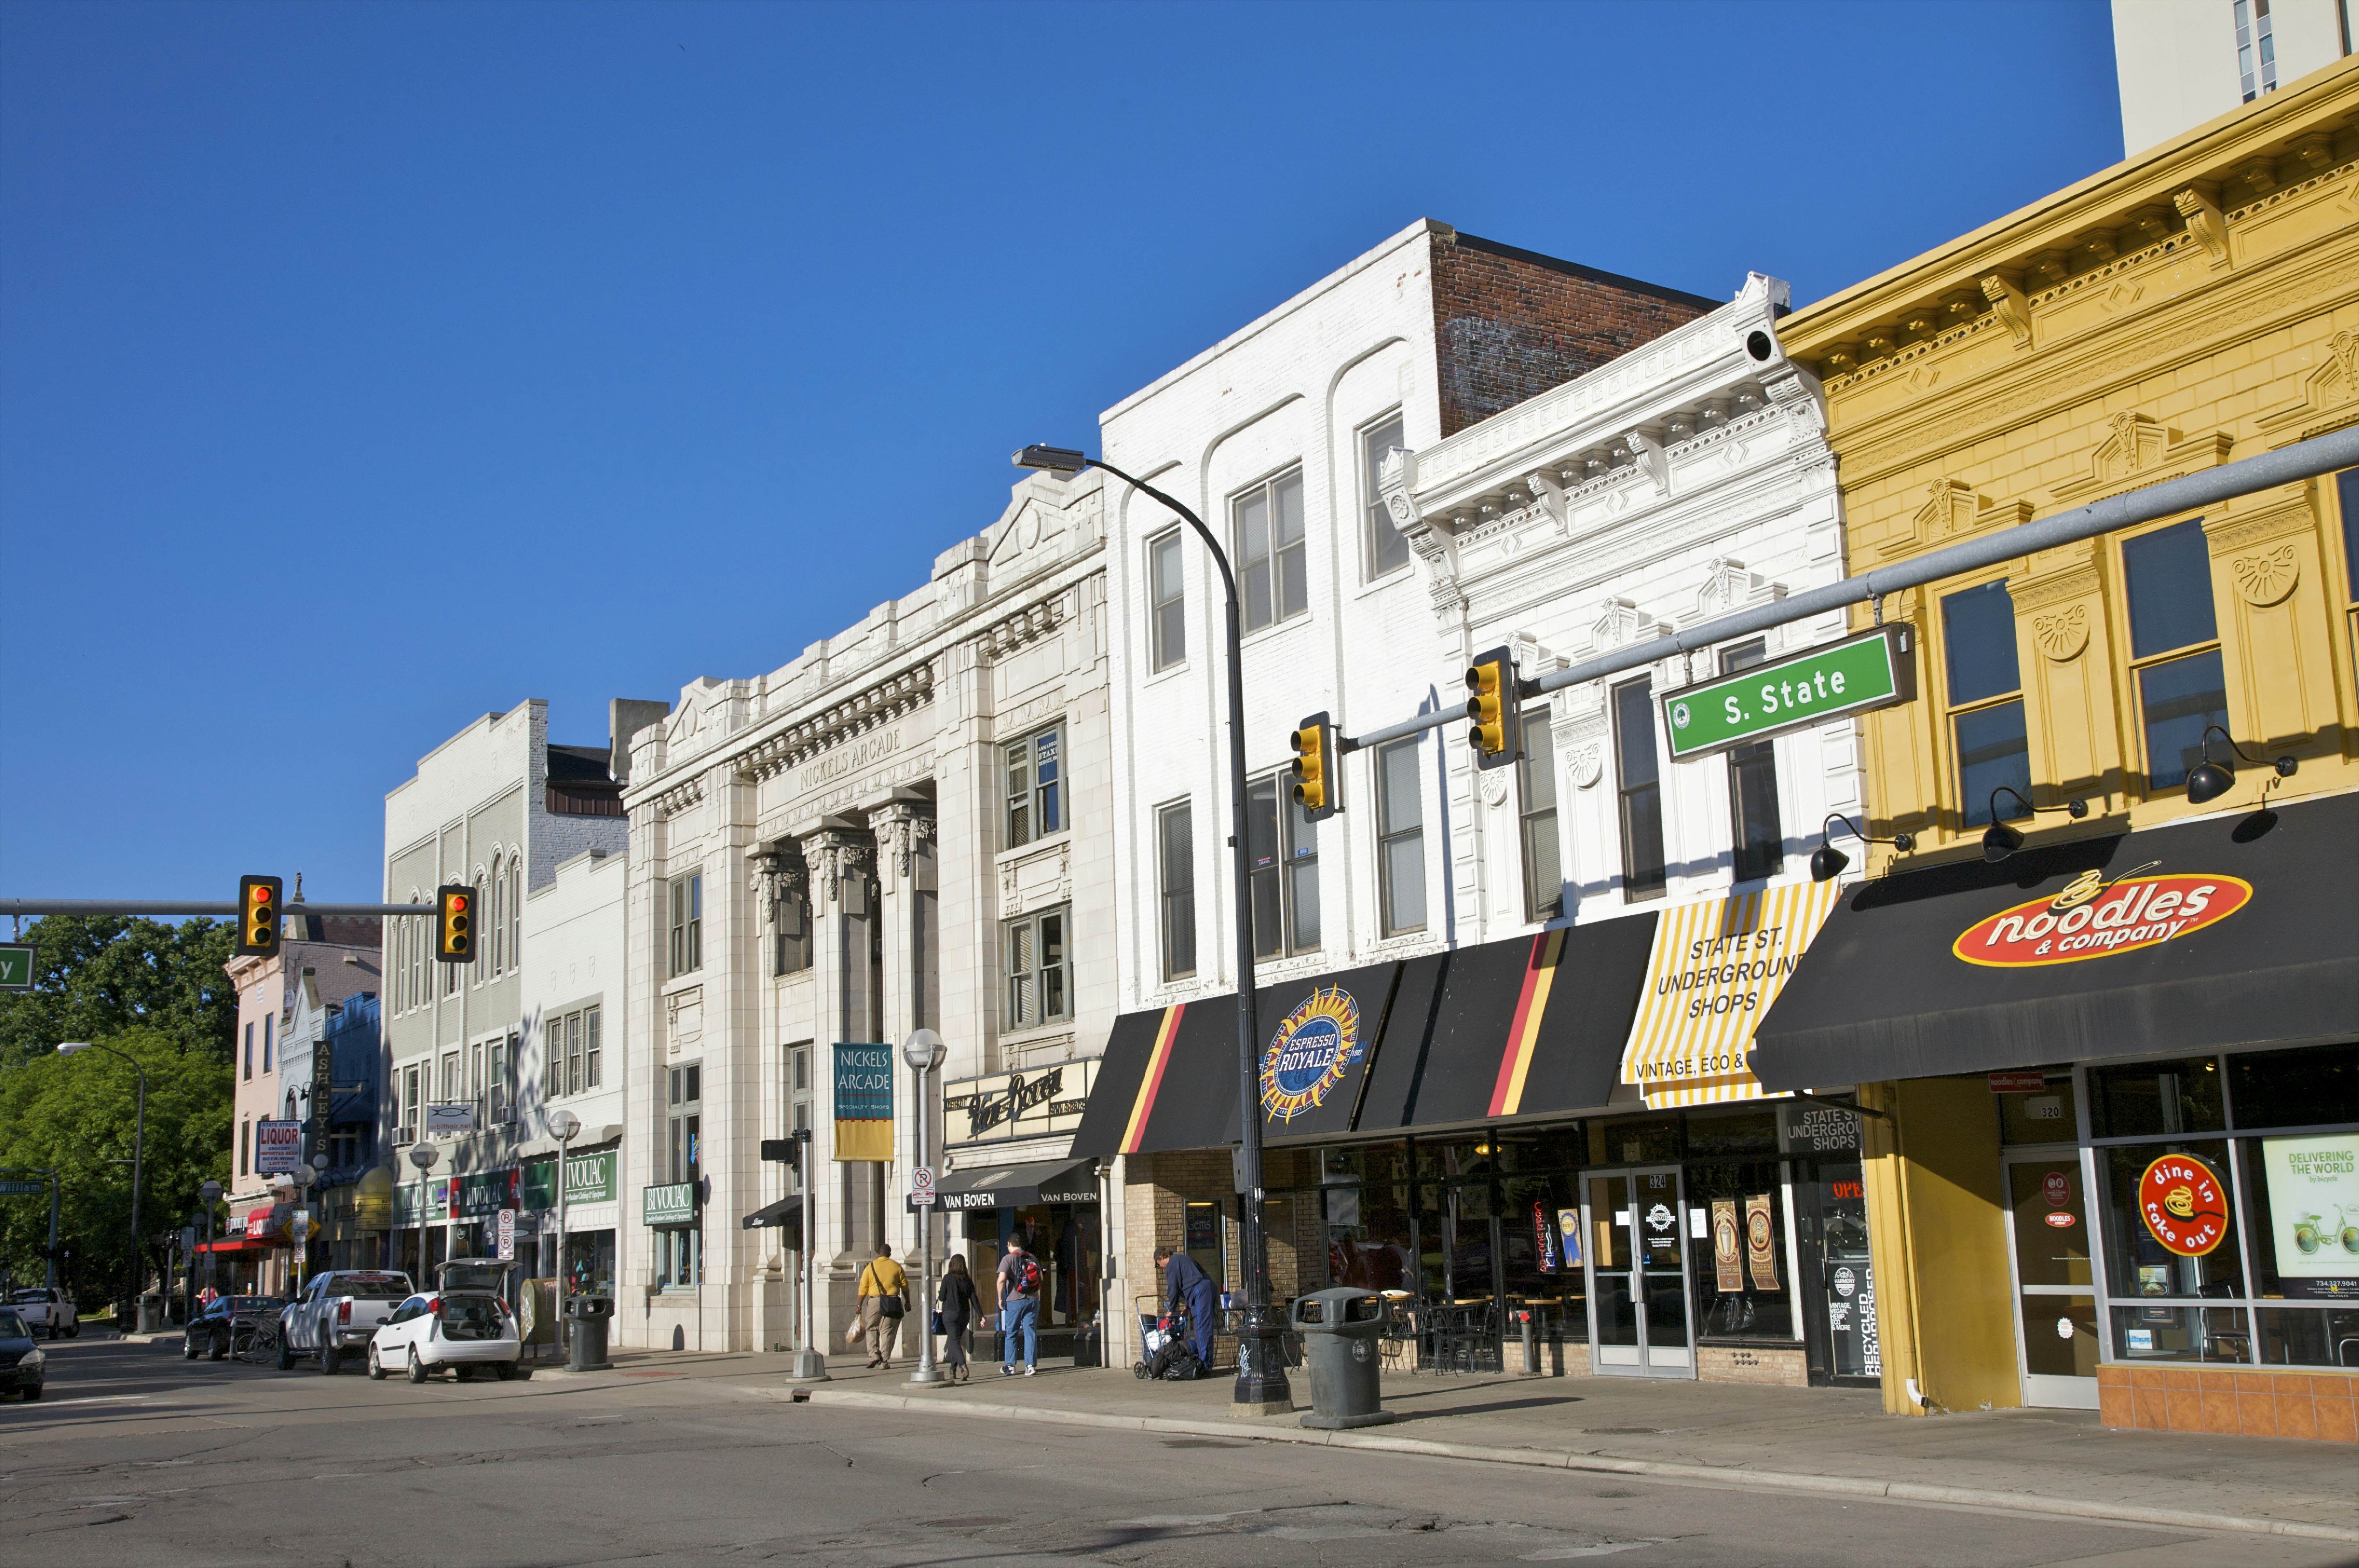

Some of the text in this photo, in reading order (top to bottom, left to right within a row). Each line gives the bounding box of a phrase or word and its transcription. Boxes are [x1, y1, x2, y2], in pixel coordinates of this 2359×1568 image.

[1724, 696, 1750, 724] S.
[1761, 670, 1846, 714] State
[800, 728, 901, 790] NICKELS ARCADE
[1986, 883, 2216, 945] noodles
[1691, 927, 1783, 960] STATE ST.
[2035, 919, 2187, 955] & company
[1, 962, 13, 980] y
[1688, 991, 1758, 1019] SHOPS
[1288, 1034, 1336, 1051] ESPRESSO
[841, 1051, 888, 1067] NICKELS
[1279, 1048, 1334, 1072] ROYALE
[1636, 1053, 1744, 1078] VINTAGE, ECO &
[838, 1074, 890, 1089] ARCADE
[2017, 1078, 2042, 1087] company
[1803, 1109, 1841, 1124] STATE
[2042, 1107, 2059, 1117] 320
[261, 1128, 298, 1145] LIQUOR
[1788, 1121, 1859, 1138] UNDERGRO
[1814, 1135, 1855, 1150] SHOPS
[2288, 1151, 2354, 1163] DELIVERING
[566, 1158, 605, 1188] IVOUAC
[2291, 1163, 2354, 1174] THE WORLD
[1651, 1176, 1665, 1187] 324
[1833, 1181, 1863, 1198] OPE
[2155, 1165, 2214, 1203] dine in
[404, 1184, 436, 1209] BIVOAC
[647, 1185, 690, 1210] BIVOUAC
[944, 1193, 995, 1209] VAN BOVEN
[1041, 1192, 1097, 1202] VAN BOVEN
[2147, 1202, 2215, 1247] take out
[1859, 1294, 1875, 1375] RECYCLED
